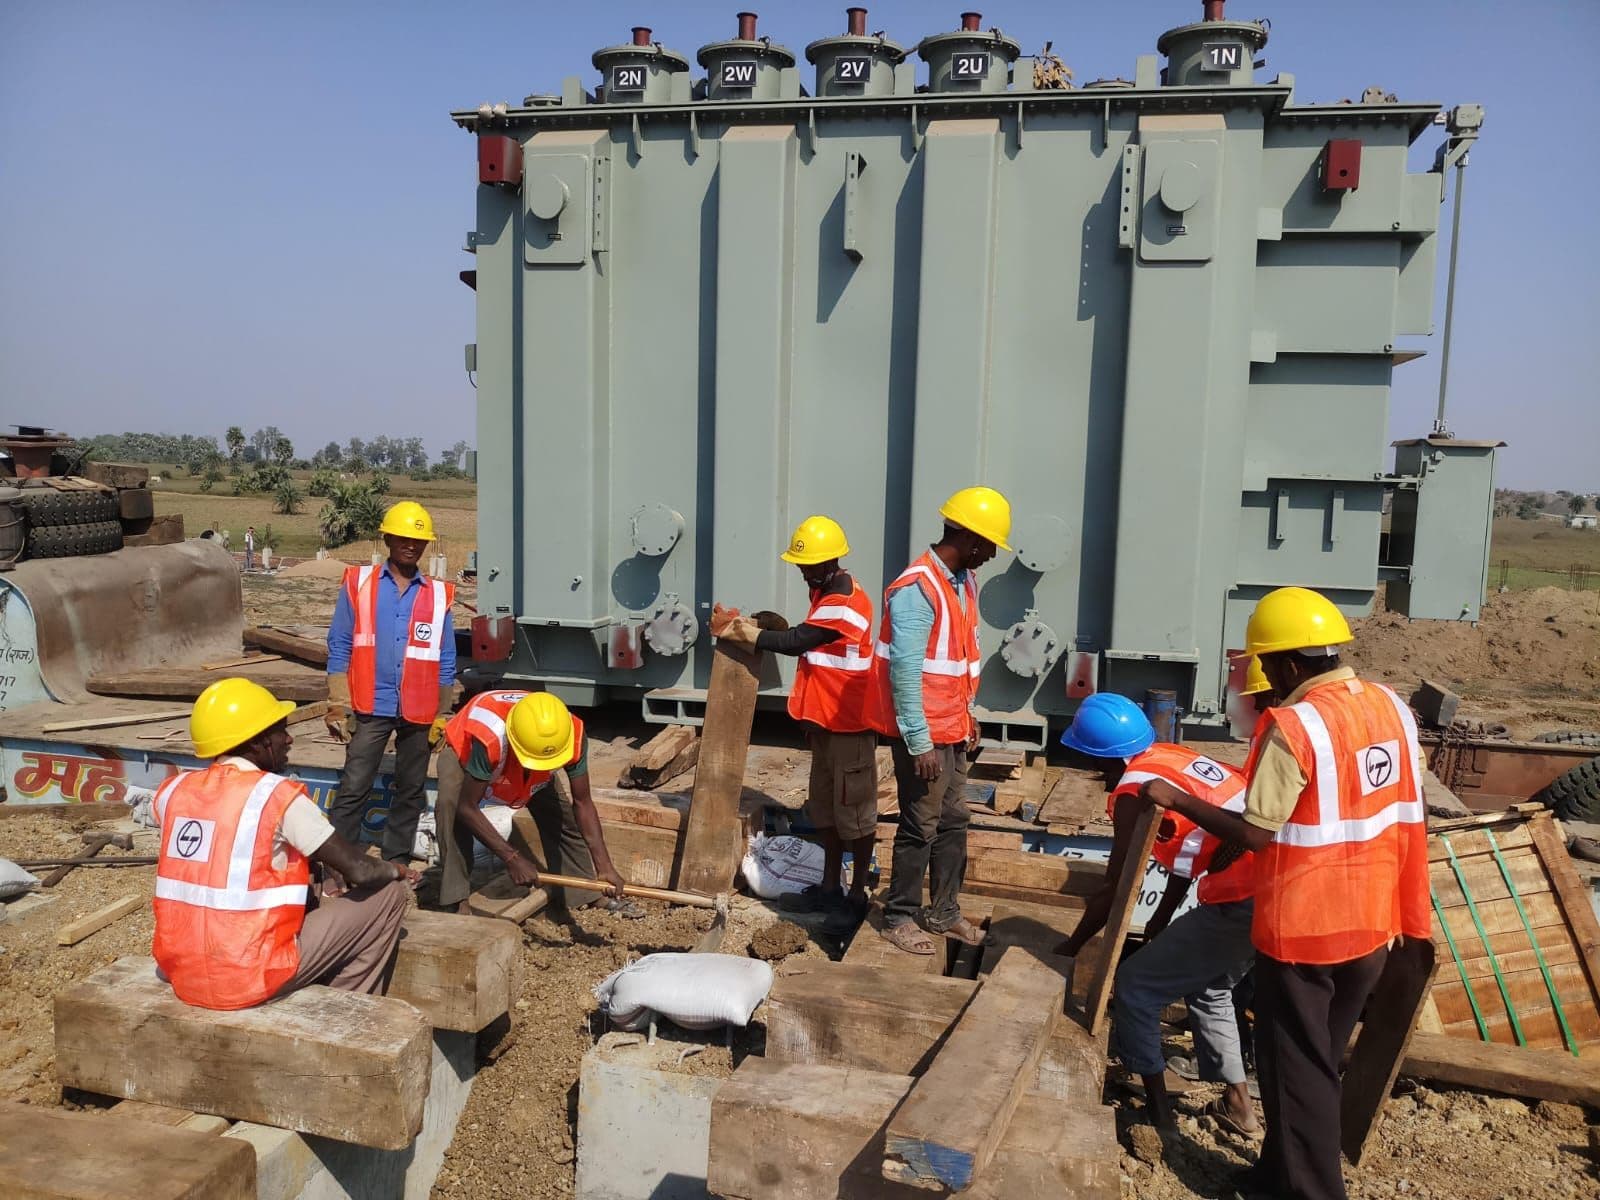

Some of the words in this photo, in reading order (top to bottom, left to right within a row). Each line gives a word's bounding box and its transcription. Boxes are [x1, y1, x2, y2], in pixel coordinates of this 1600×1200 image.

[1210, 47, 1236, 65] 1N
[725, 66, 753, 81] 2W
[840, 61, 865, 77] 2V
[958, 57, 983, 75] 2U
[619, 70, 641, 86] 2N
